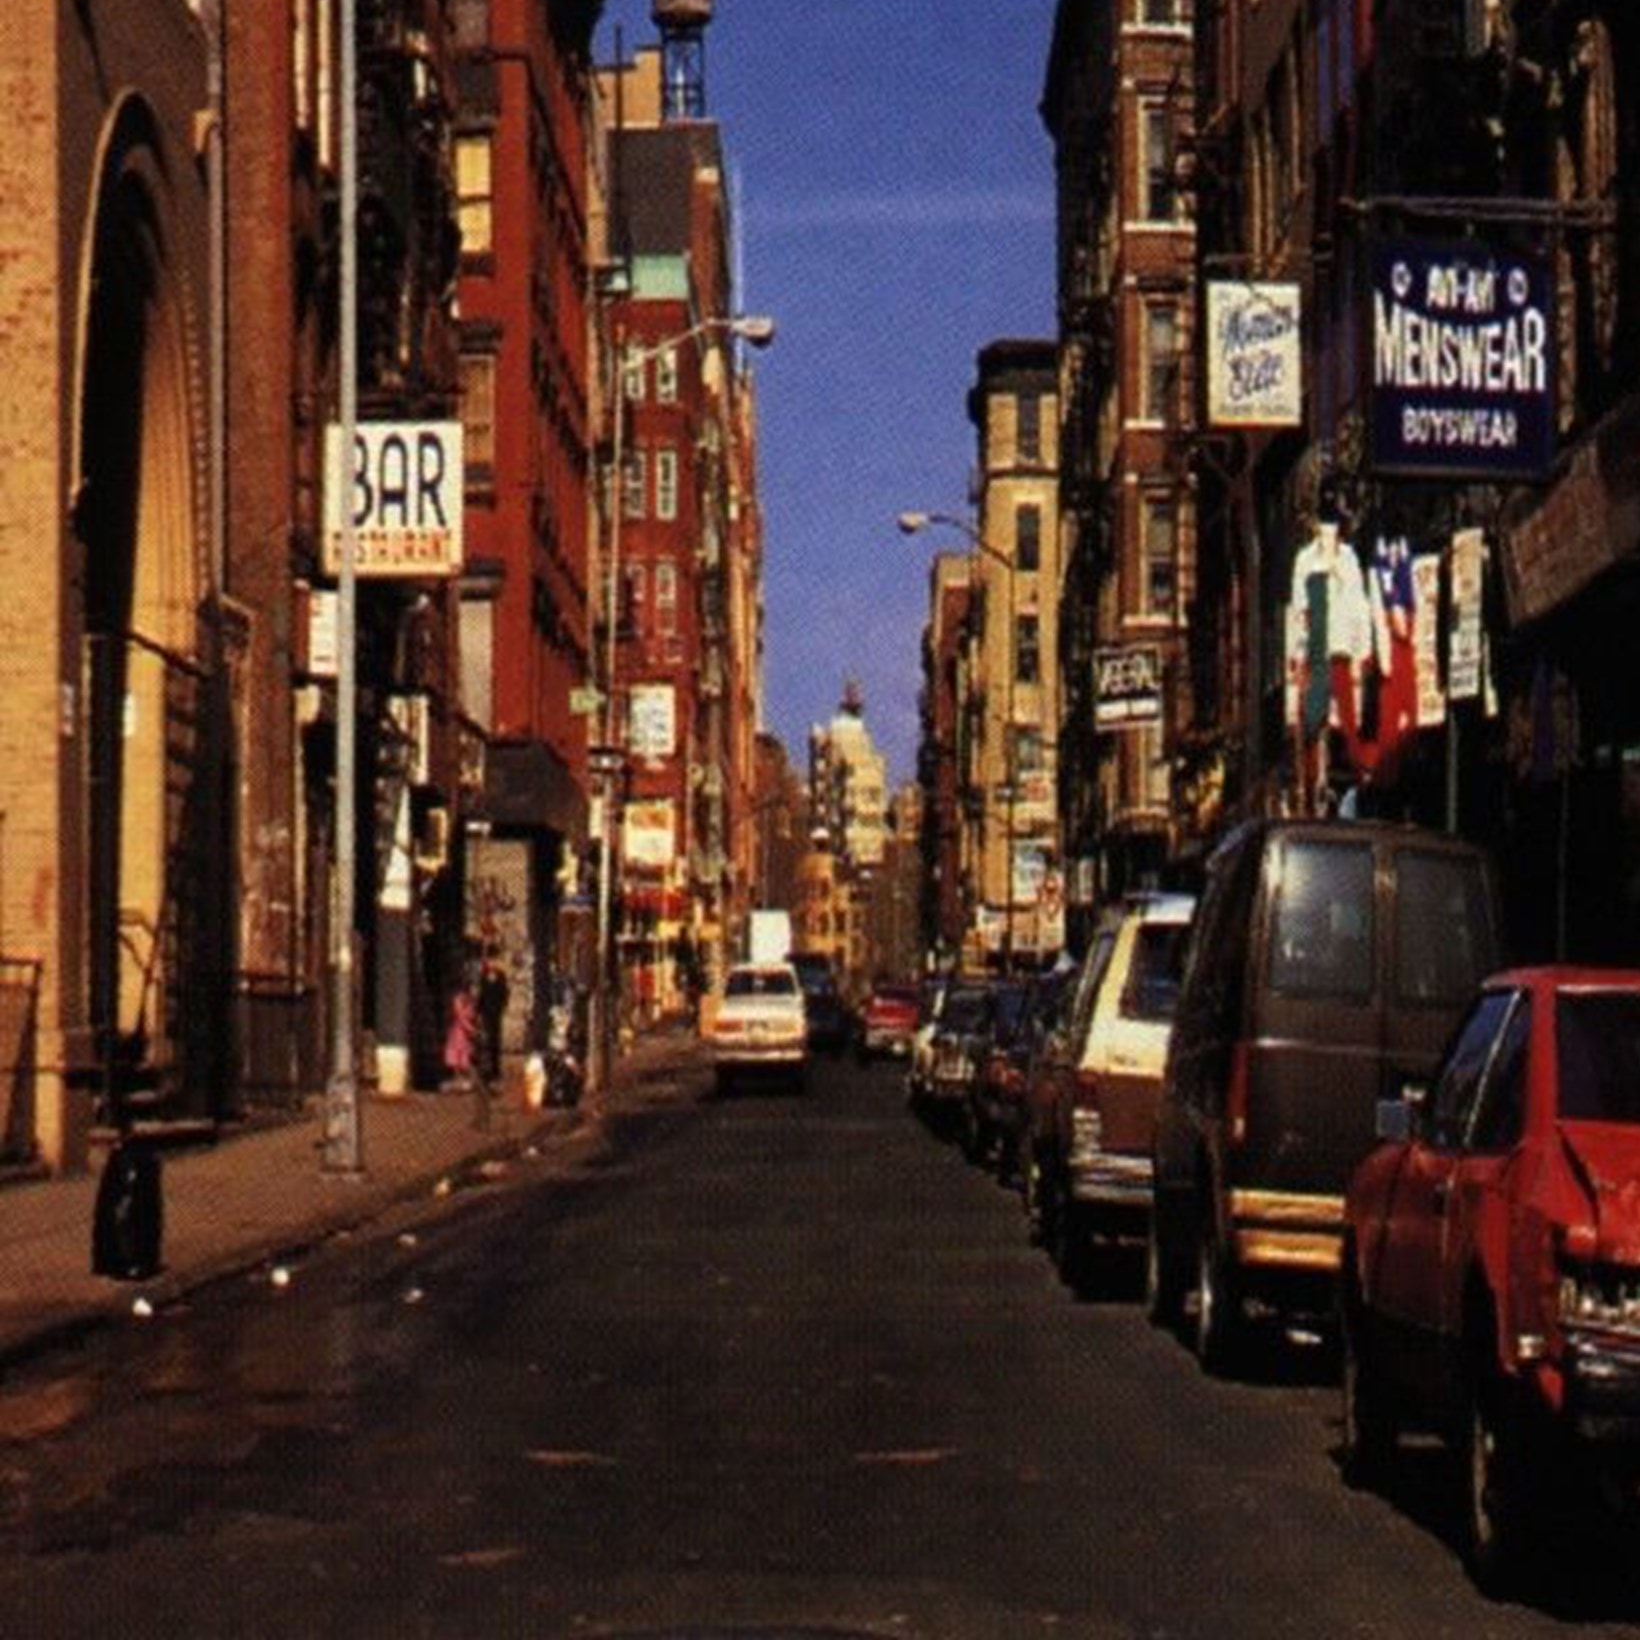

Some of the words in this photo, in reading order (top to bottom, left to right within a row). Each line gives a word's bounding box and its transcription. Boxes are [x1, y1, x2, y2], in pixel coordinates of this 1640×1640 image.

[1374, 289, 1546, 393] MENSWEAR
[1402, 405, 1518, 447] BOYSWEAR
[353, 431, 448, 528] BAR
